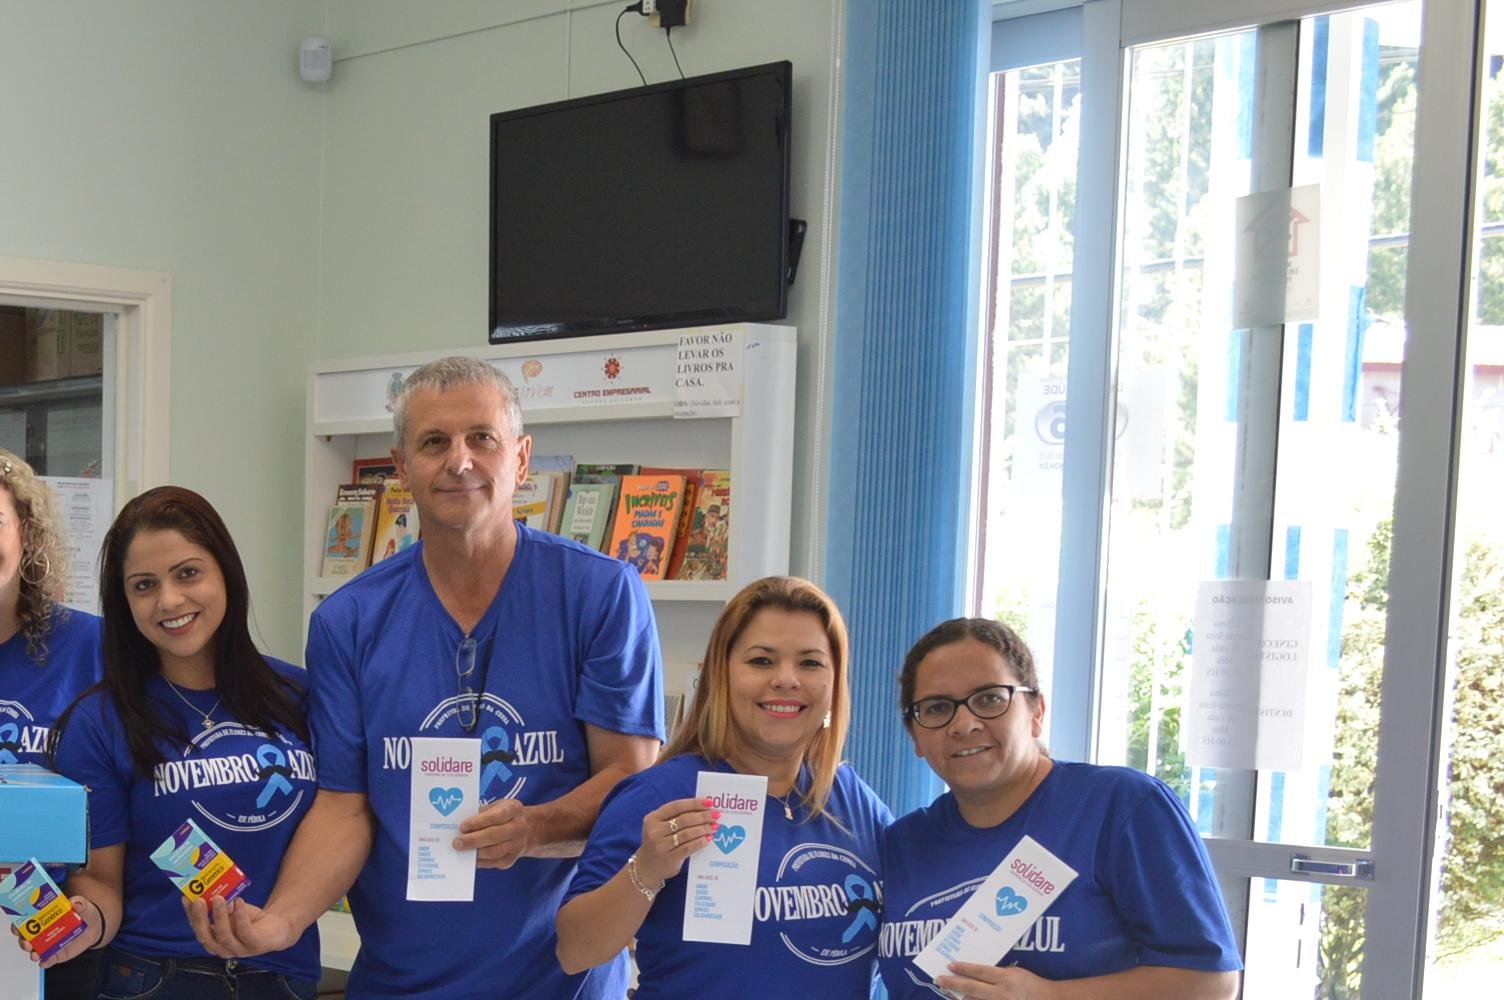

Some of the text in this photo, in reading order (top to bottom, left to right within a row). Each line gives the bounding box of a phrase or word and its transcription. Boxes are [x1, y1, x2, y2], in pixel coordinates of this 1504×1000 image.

[679, 332, 733, 346] FAVOR NÃO
[678, 348, 724, 360] LEVAR OS
[677, 362, 734, 374] LIVROS PRA
[675, 378, 704, 388] CASA.
[573, 387, 652, 398] CENTRO EMPRESARIAL
[511, 730, 564, 766] AZUL
[420, 756, 473, 773] solidare
[154, 753, 260, 797] NOVEMBRO
[1010, 858, 1055, 896] solidare
[188, 879, 205, 895] G
[755, 883, 848, 922] OVEMBRO
[25, 919, 42, 935] G
